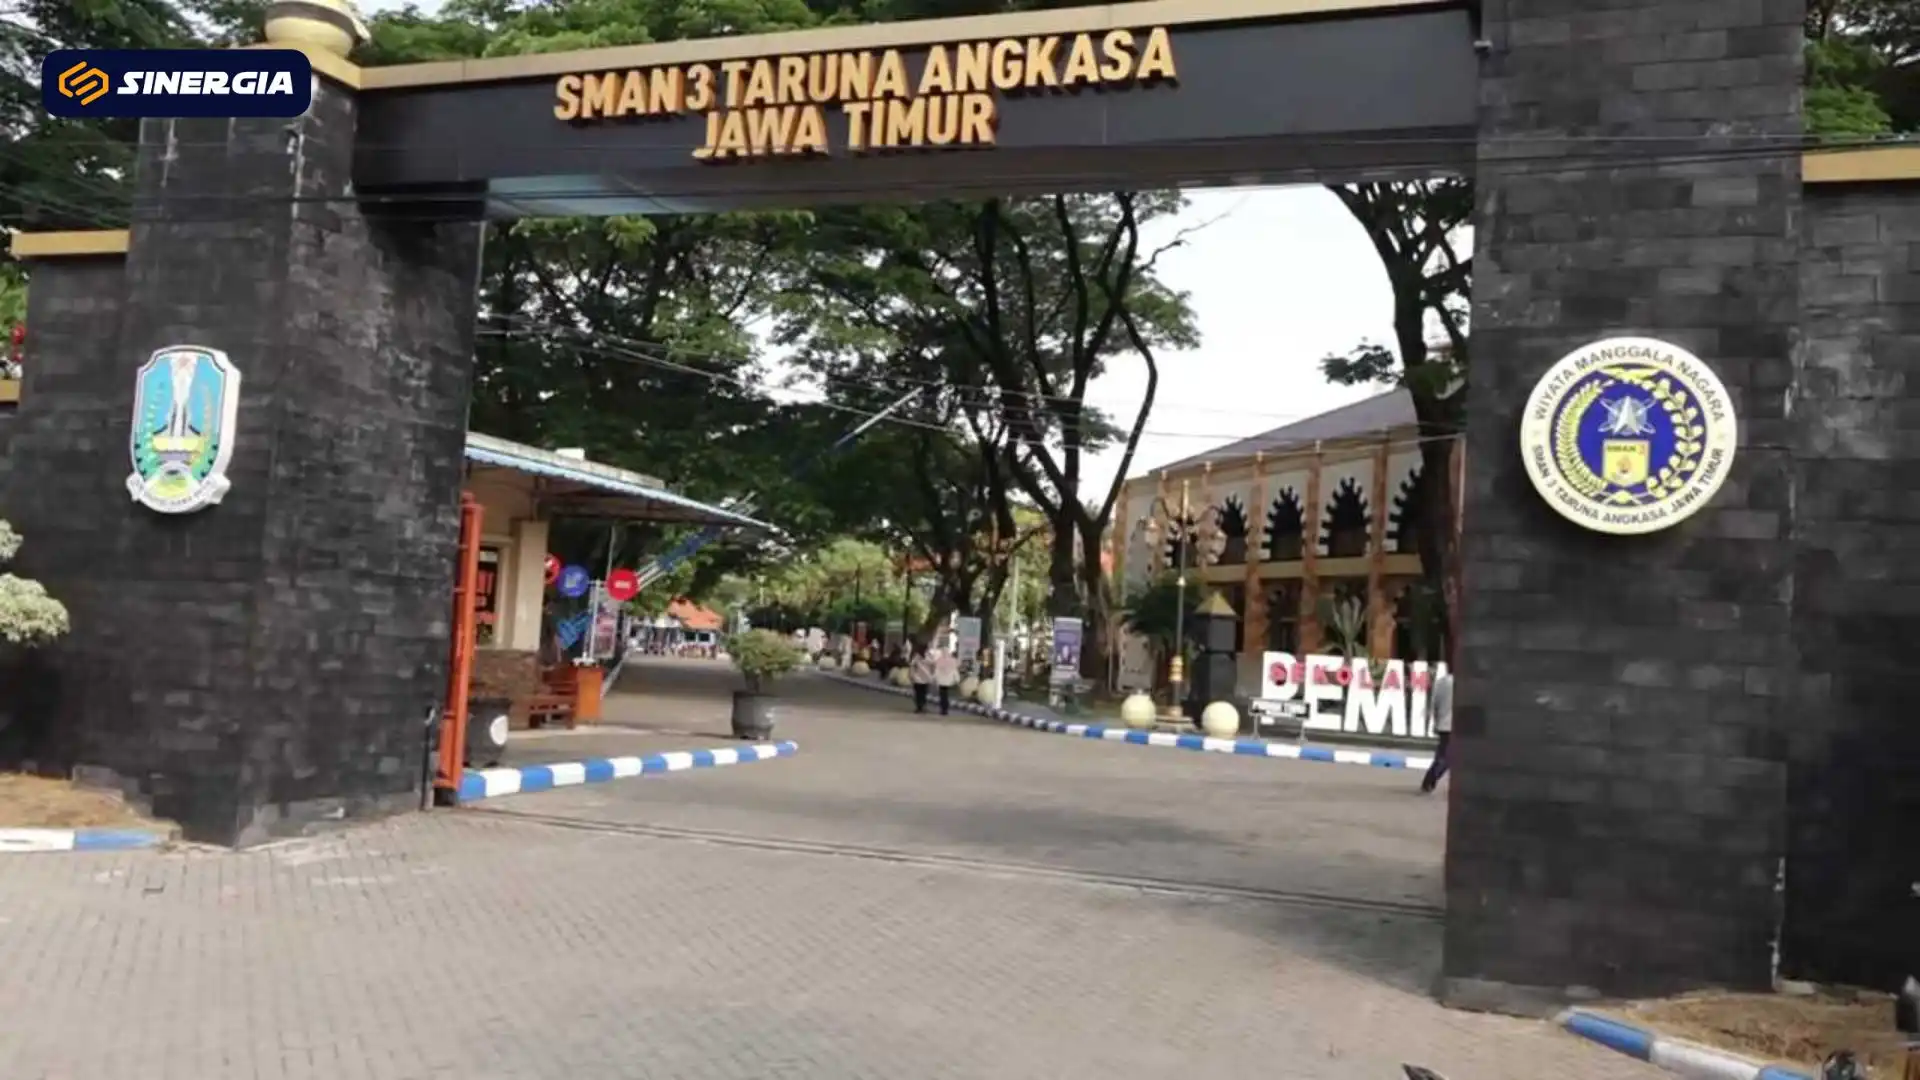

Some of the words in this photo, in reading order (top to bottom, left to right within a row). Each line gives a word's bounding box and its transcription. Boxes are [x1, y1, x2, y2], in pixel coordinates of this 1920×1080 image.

[553, 64, 682, 122] SMAN
[686, 63, 715, 110] 3
[721, 49, 910, 109] TARUNA
[917, 27, 1176, 96] ANGKASA
[692, 108, 828, 160] JAWA
[843, 92, 997, 151] TIMUR
[1535, 368, 1577, 421] WIYATA
[1574, 346, 1675, 371] MANGGALA
[1676, 360, 1726, 423] NAGARA
[1554, 486, 1599, 520] TARUNA
[1602, 509, 1667, 525] ANGKASA
[1671, 486, 1704, 513] JAWA
[1702, 447, 1725, 490] TIMUR
